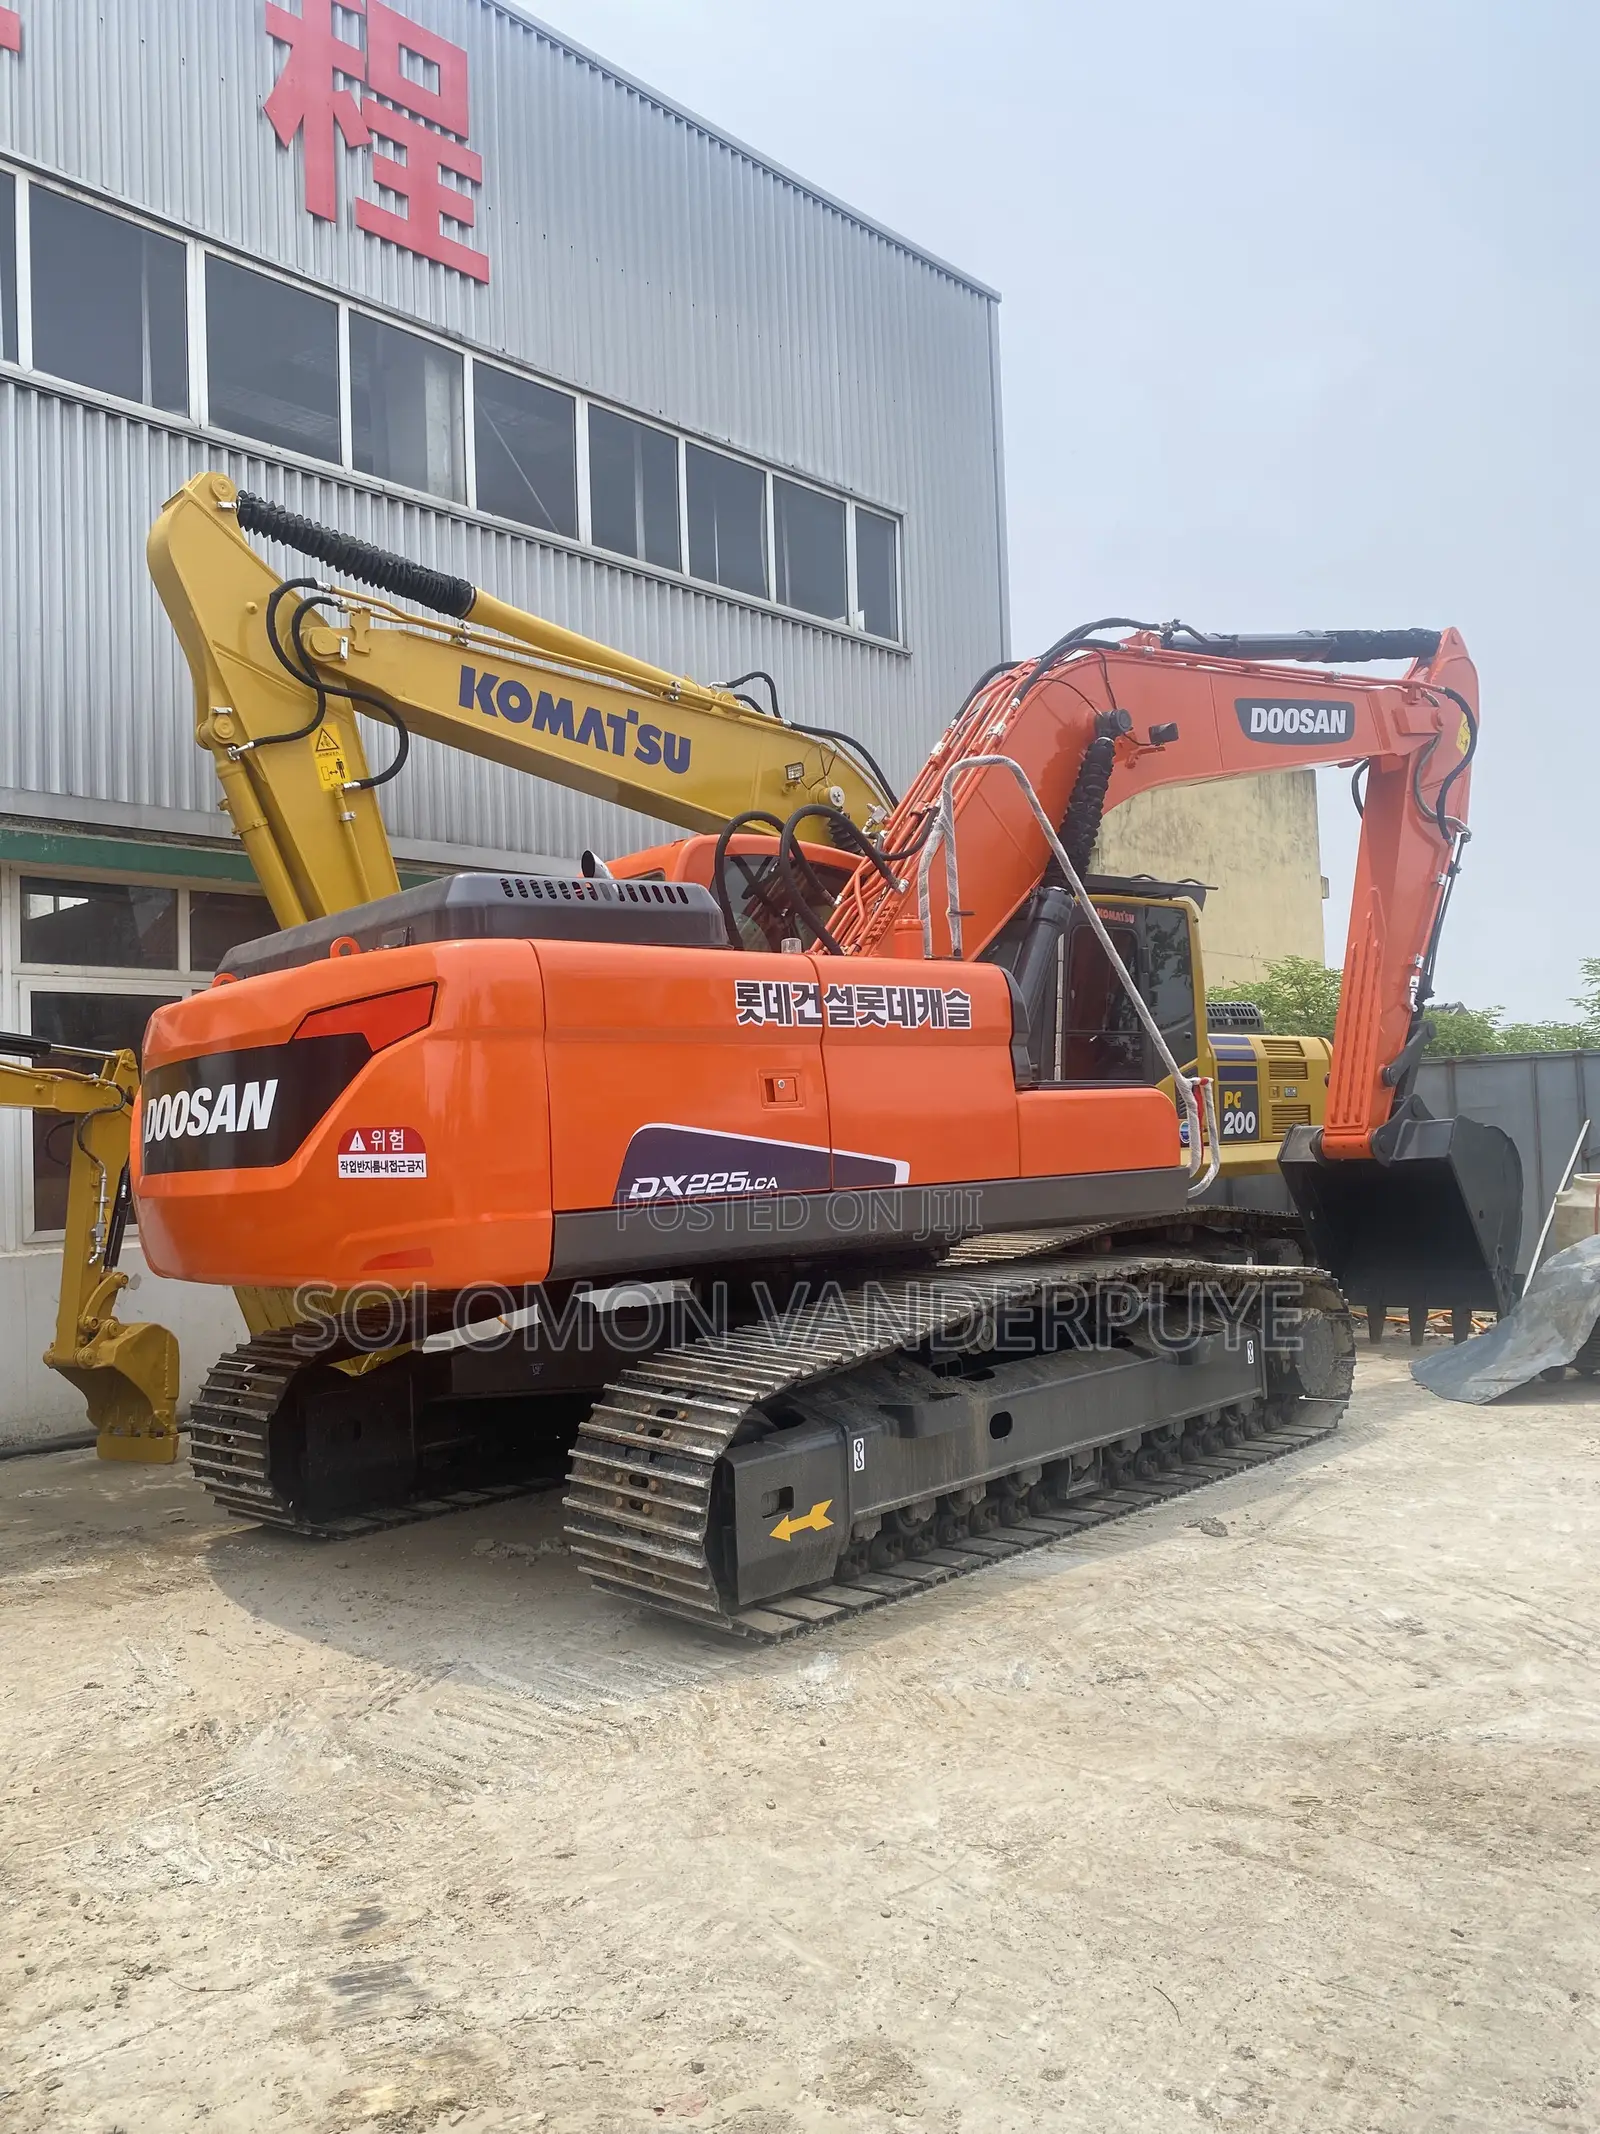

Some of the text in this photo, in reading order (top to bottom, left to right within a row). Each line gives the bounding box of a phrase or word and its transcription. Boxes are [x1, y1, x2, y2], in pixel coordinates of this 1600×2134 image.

[459, 665, 691, 774] KOMATSU
[1250, 707, 1346, 734] DOOSAN
[144, 1079, 278, 1144] DOOSAN
[1224, 1091, 1242, 1109] PC
[1223, 1111, 1256, 1135] 200
[370, 1128, 404, 1151] 위험
